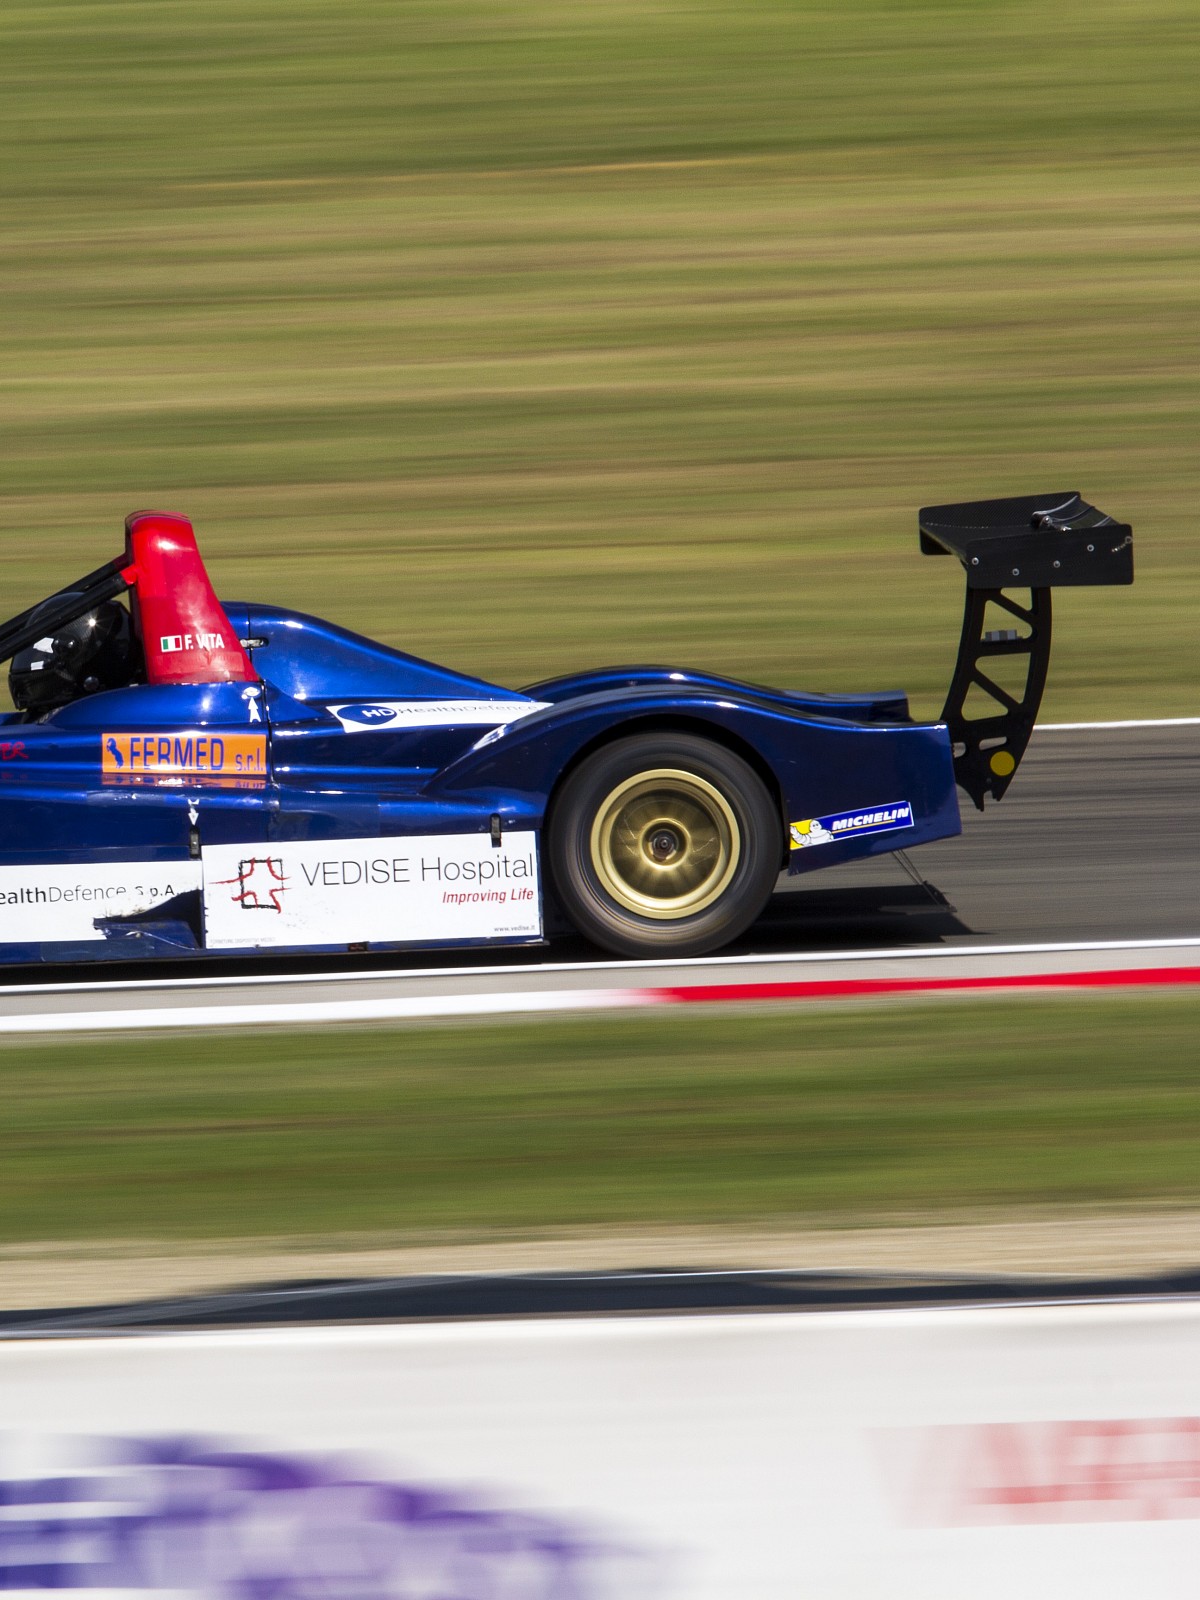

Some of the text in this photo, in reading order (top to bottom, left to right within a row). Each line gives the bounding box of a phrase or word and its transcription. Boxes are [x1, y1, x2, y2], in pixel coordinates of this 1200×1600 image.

[195, 633, 225, 649] VITA
[362, 706, 395, 718] HD
[129, 737, 264, 772] FERMED s.r.l.
[832, 807, 910, 831] MICHELIN
[301, 853, 534, 886] VEDISE Hospital
[135, 884, 180, 901] Sp.A.
[442, 887, 534, 905] Improving Life
